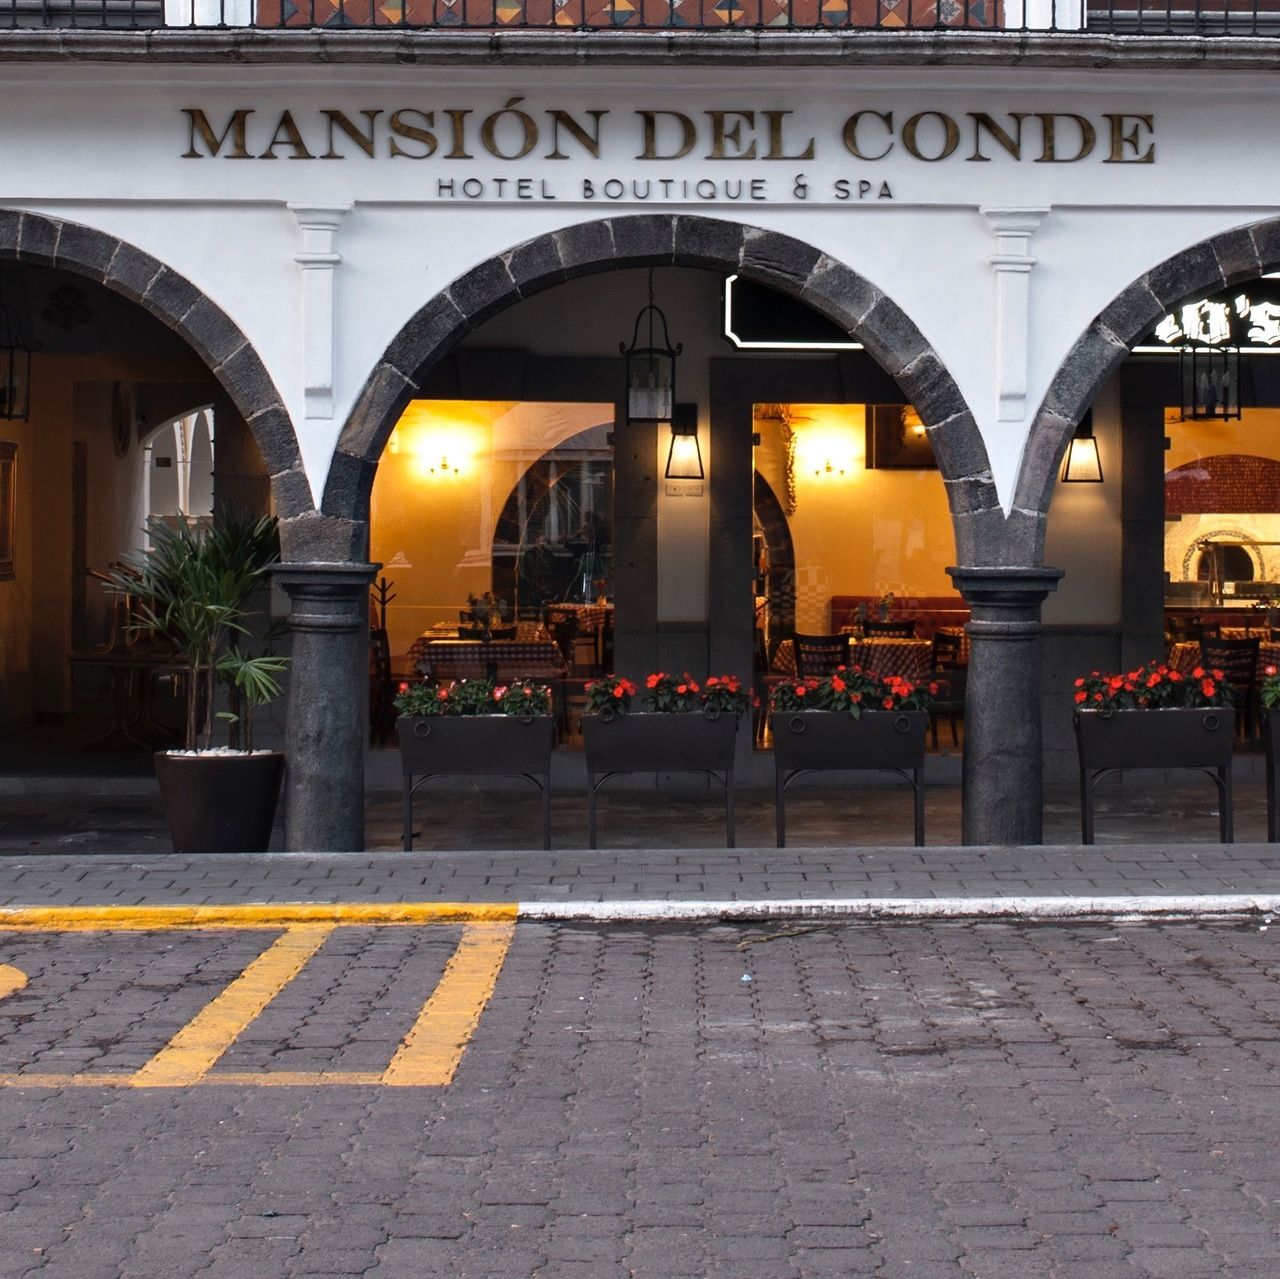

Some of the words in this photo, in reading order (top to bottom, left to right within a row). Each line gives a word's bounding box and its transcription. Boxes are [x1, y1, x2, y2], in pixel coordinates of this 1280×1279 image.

[180, 96, 610, 161] MANSIÓN
[634, 109, 816, 161] DEL
[841, 109, 1156, 164] CONDE
[437, 177, 556, 200] HOTEL
[582, 177, 767, 201] BOUTIQUE
[792, 173, 810, 201] &
[833, 178, 895, 200] SPA
